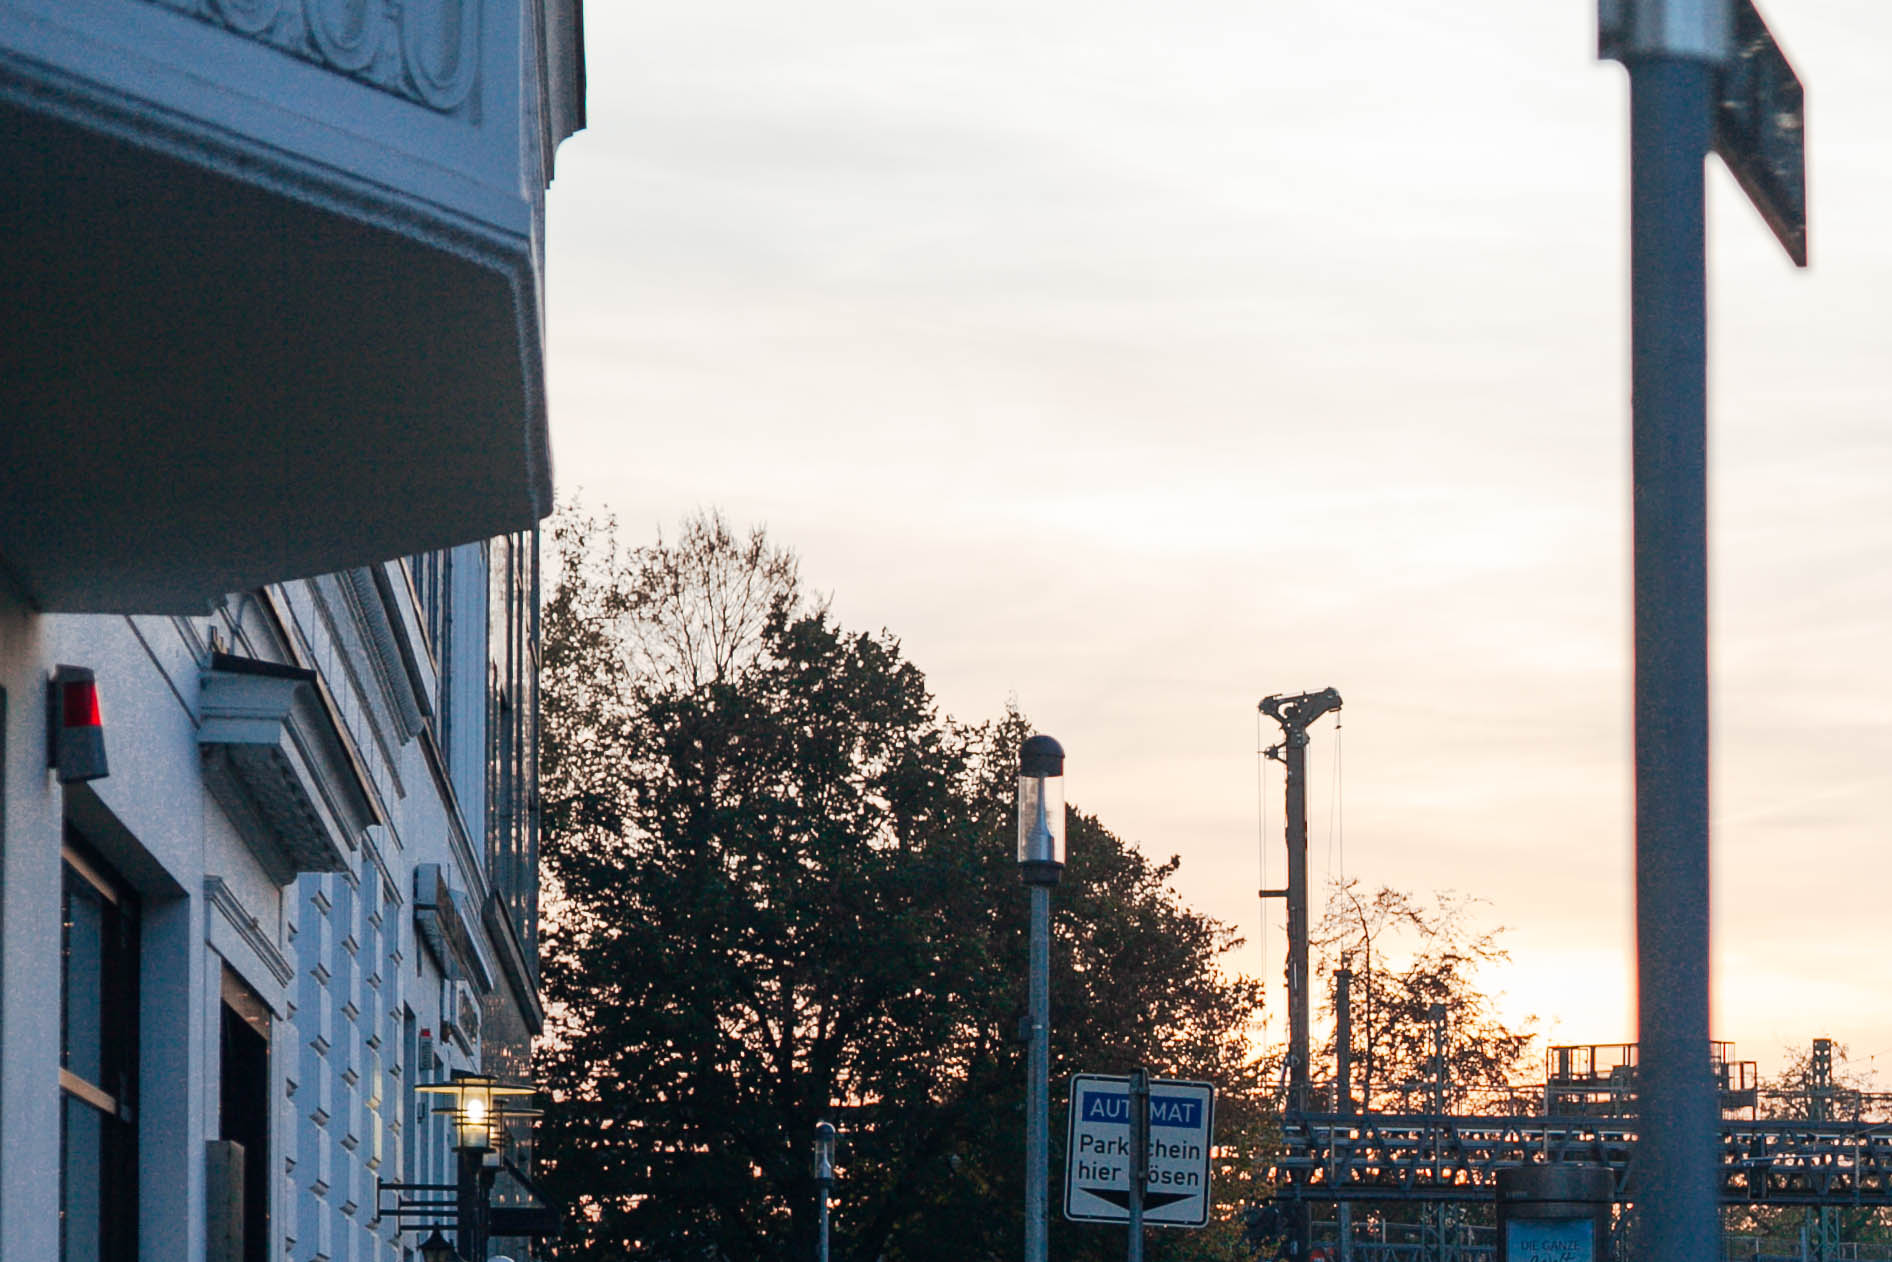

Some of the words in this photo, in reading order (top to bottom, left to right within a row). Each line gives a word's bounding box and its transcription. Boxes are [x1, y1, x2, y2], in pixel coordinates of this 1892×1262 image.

[1090, 1098, 1195, 1122] AUTMAT
[1080, 1134, 1200, 1160] Parkchein
[1078, 1161, 1121, 1181] hier
[1146, 1165, 1199, 1186] ösen
[1521, 1241, 1537, 1250] DIE
[1542, 1241, 1578, 1250] GANZE
